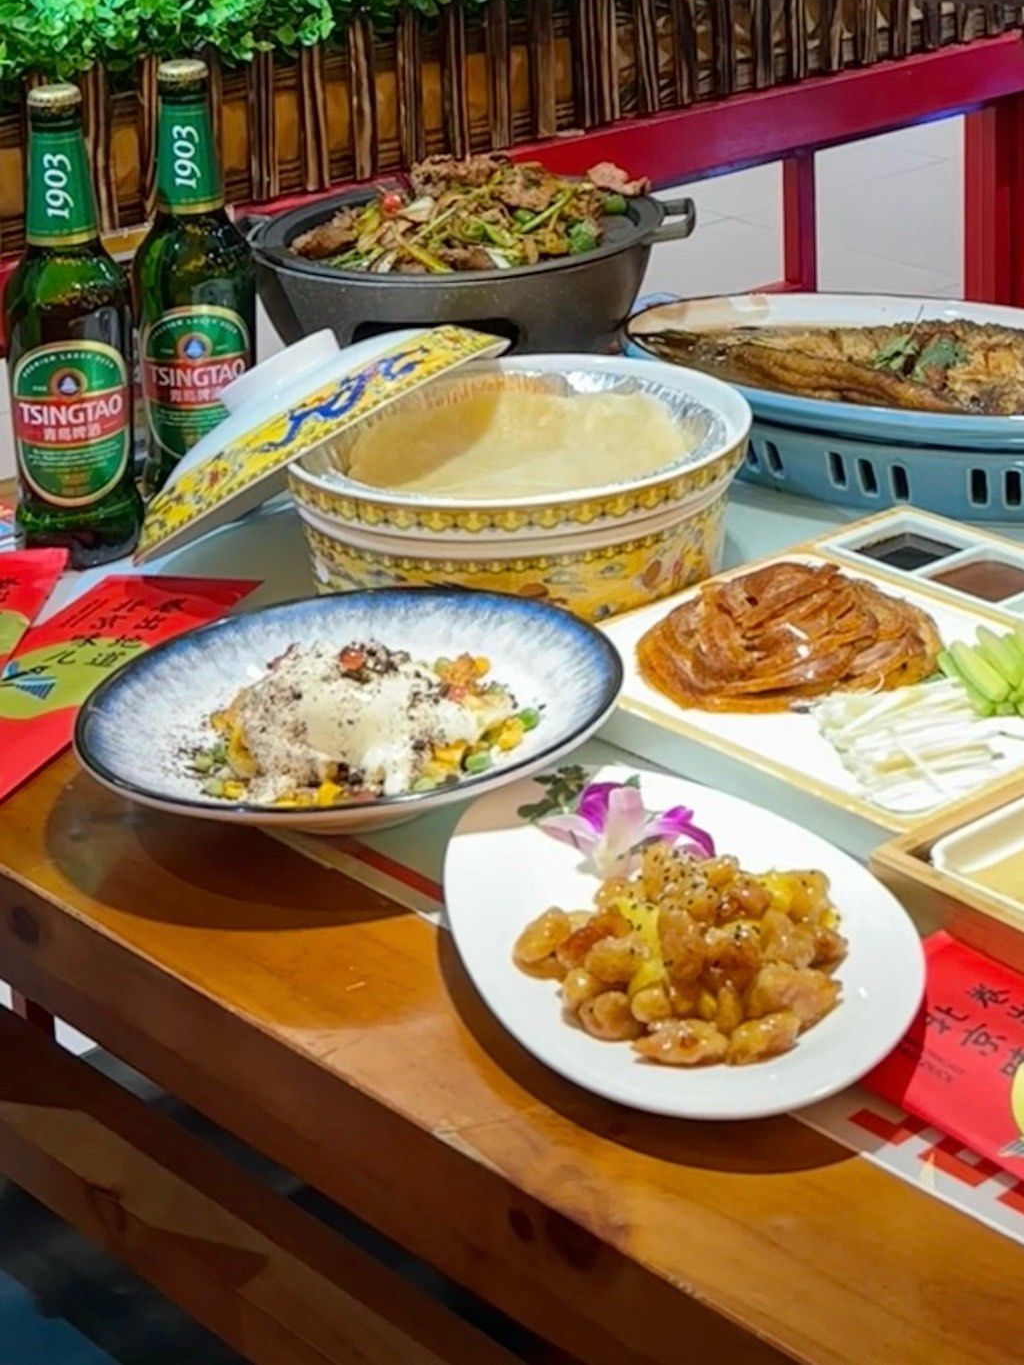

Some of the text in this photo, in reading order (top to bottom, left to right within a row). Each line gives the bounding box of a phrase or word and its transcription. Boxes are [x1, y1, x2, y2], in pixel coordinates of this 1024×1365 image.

[171, 124, 202, 190] 1903
[42, 152, 75, 220] 1903
[151, 358, 246, 387] TSINGTAO
[19, 393, 123, 427] TSINGTAO
